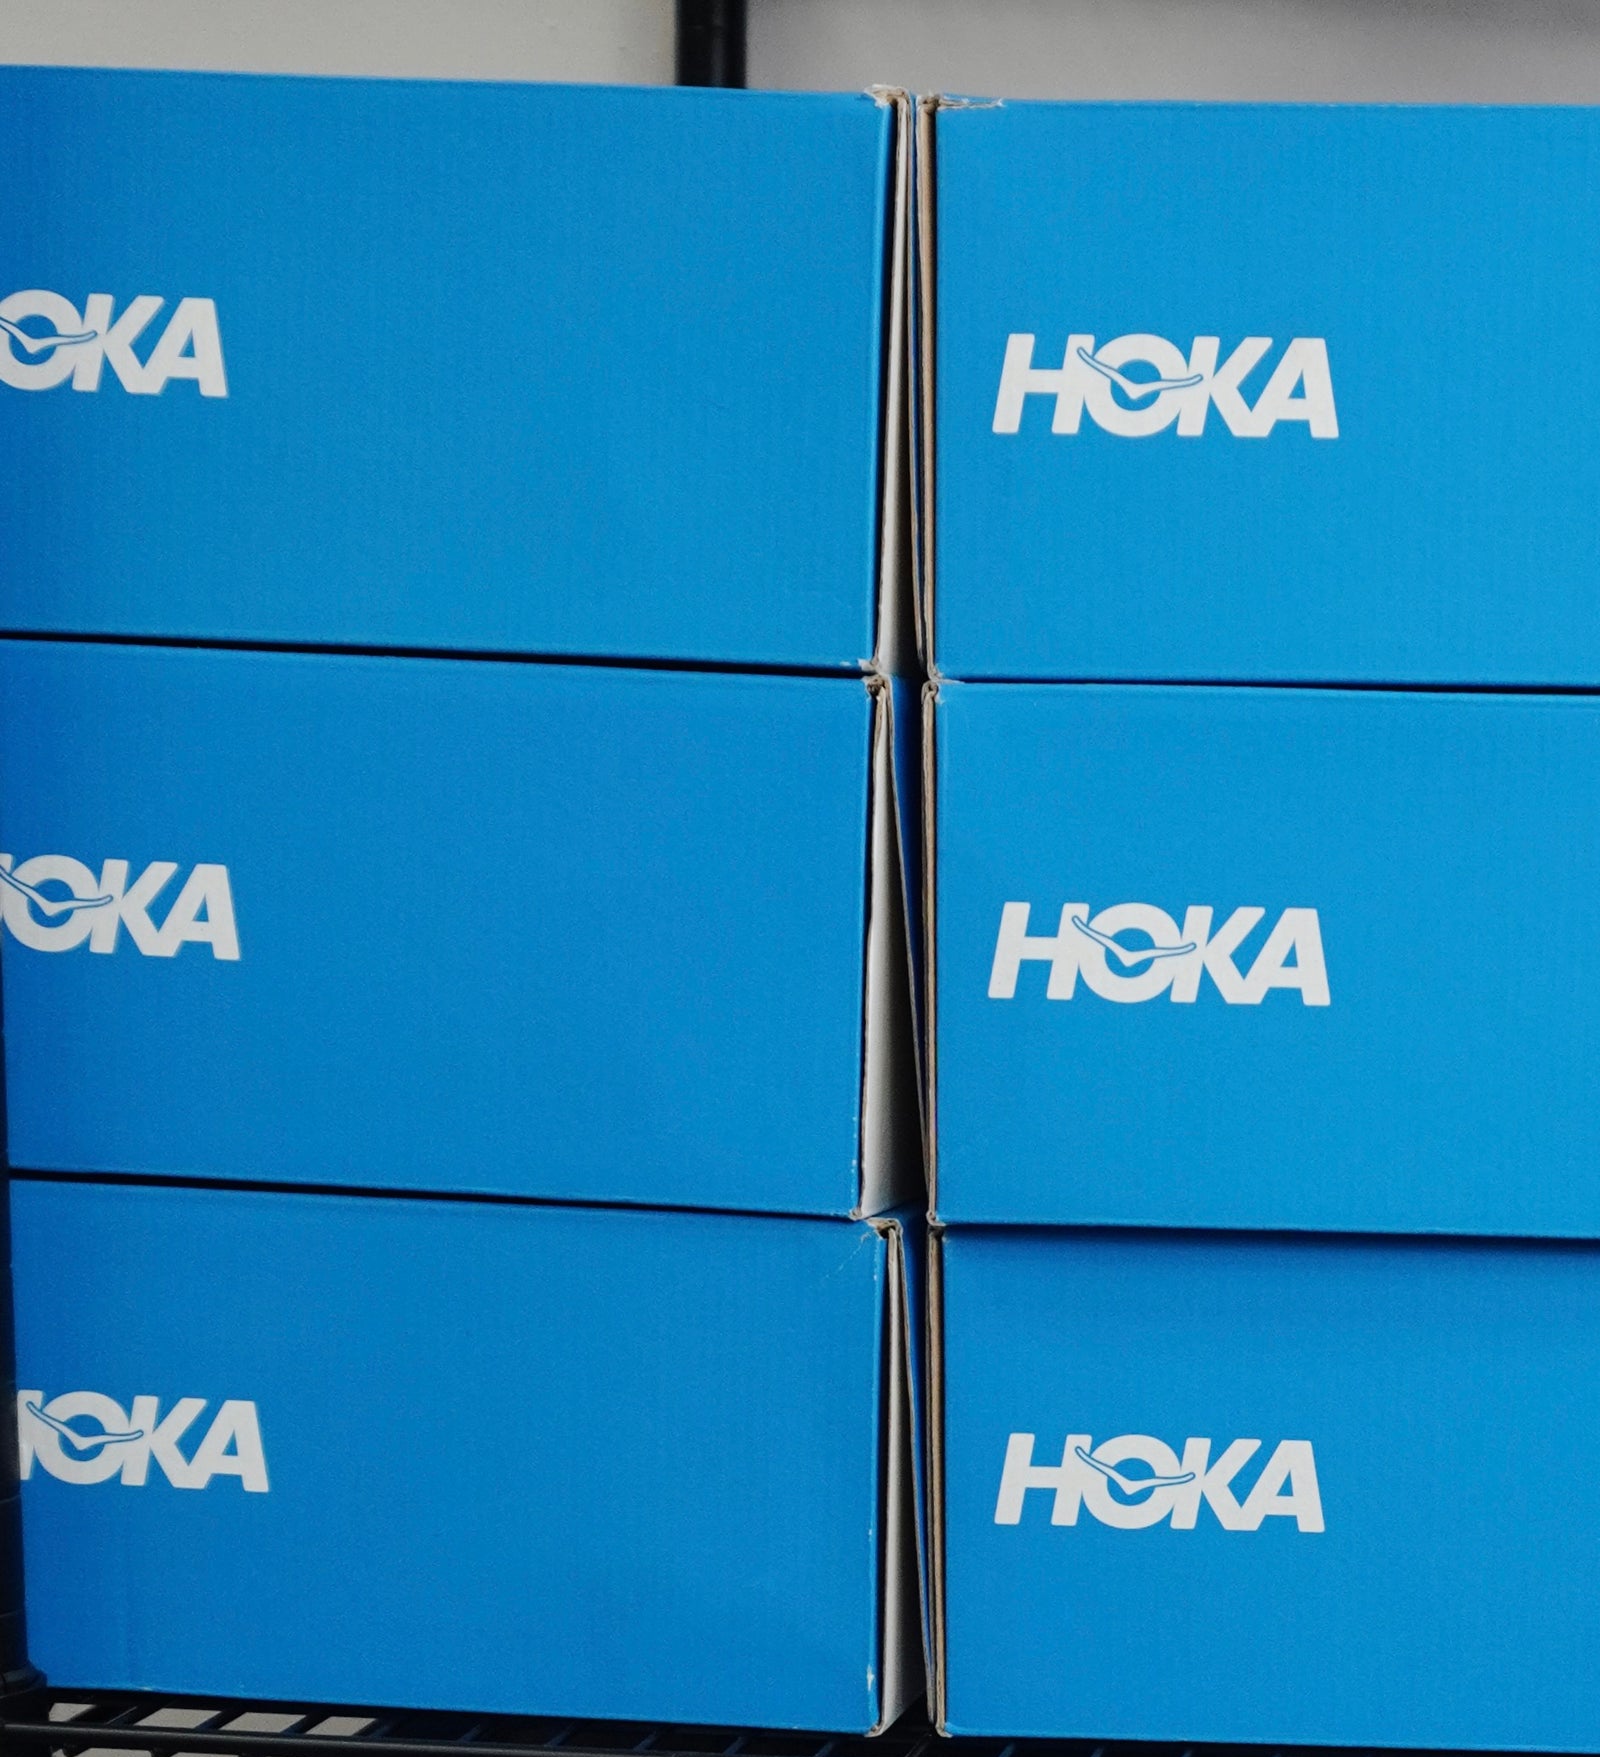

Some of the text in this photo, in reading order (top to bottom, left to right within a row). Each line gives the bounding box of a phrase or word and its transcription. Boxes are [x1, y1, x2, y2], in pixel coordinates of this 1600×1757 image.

[992, 333, 1339, 439] HOKA
[0, 853, 240, 961] OKA
[988, 901, 1331, 1006] HOKA
[994, 1433, 1325, 1533] HOKA
